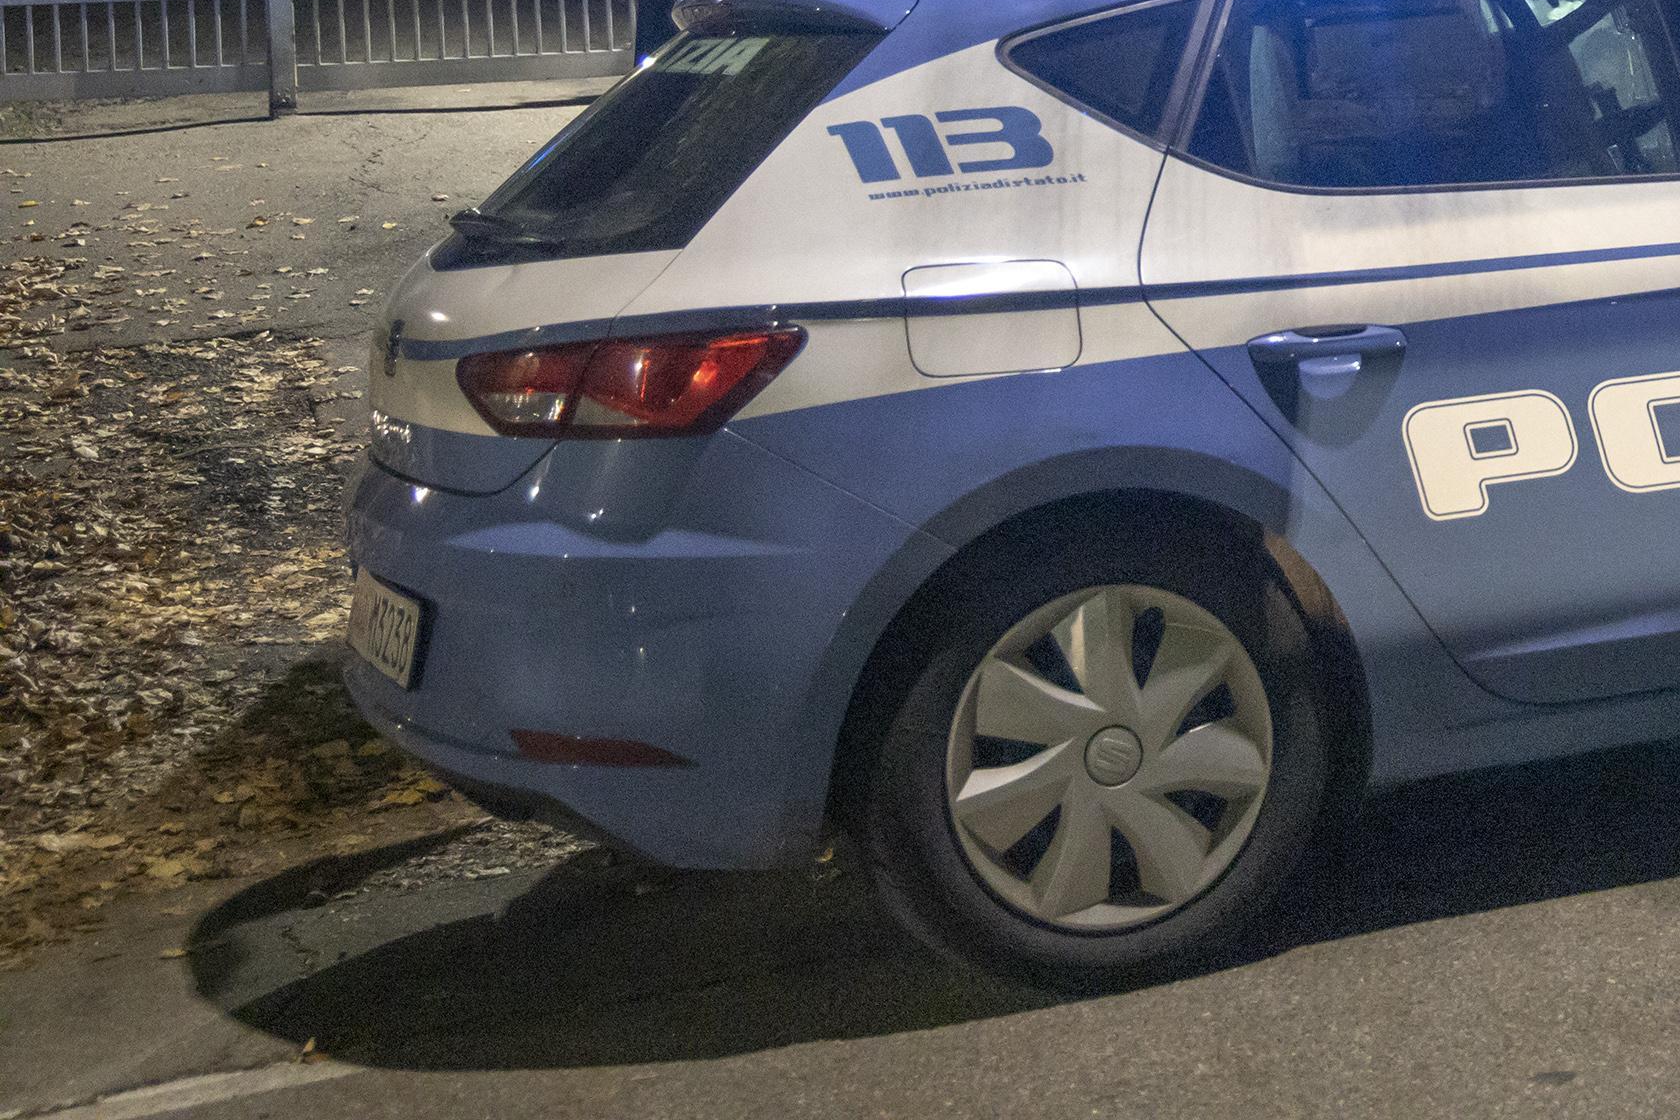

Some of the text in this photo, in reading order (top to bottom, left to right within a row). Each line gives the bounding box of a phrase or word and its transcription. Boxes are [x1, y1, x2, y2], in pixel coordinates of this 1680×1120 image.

[655, 37, 770, 76] IZIA
[826, 106, 1054, 184] 113
[868, 173, 1088, 201] www.poliziadistato.it
